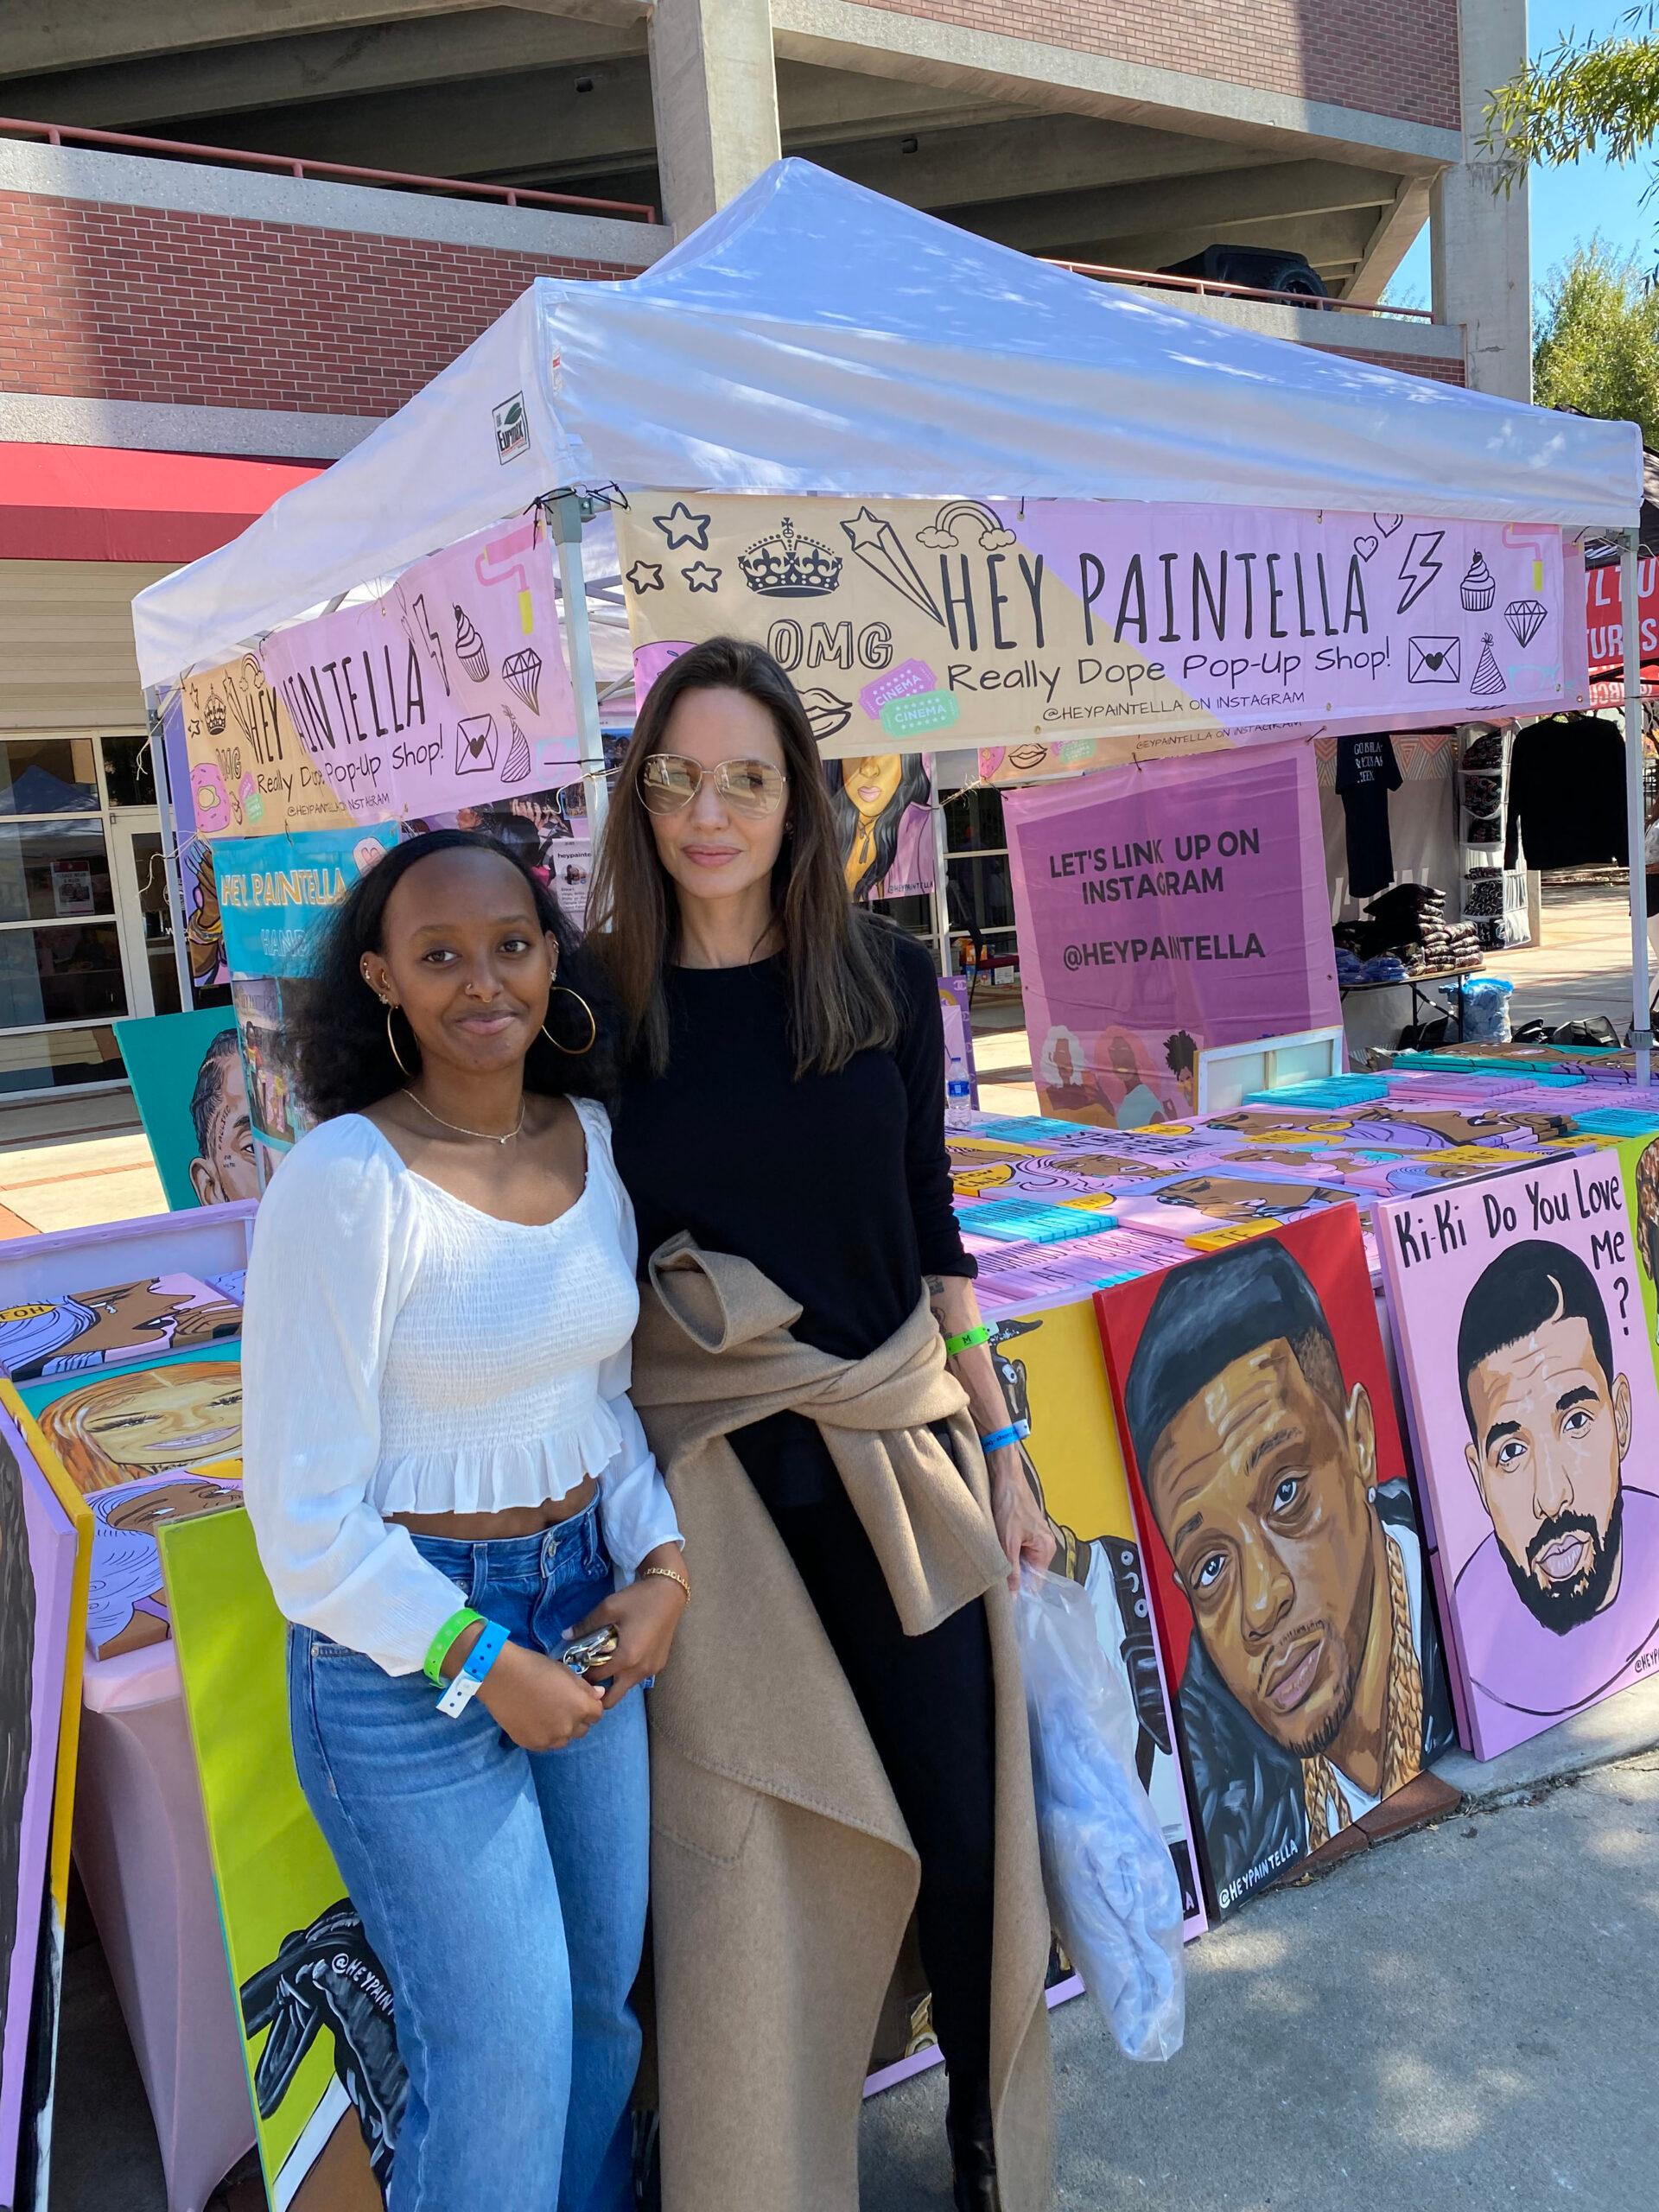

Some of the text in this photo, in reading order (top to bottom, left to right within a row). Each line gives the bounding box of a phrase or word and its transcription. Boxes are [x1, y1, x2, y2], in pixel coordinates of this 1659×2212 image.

[939, 550, 1369, 652] HEY PAINTELLA
[766, 619, 893, 672] OMG
[947, 636, 1391, 702] Really Dope Pop-Up Shop!
[874, 675, 922, 706] CINEMA
[894, 704, 947, 723] CINEMA
[1042, 692, 1305, 721] @HEYPAINTELLA ON INSTAGRAM
[245, 686, 283, 765] HEY
[1215, 728, 1230, 737] ON
[257, 768, 293, 803] Really
[392, 722, 444, 776] Shop!
[1049, 828, 1260, 879] LET'S LINK UP ON
[1394, 1168, 1622, 1268] Ki-Ki Do You Love
[1029, 1266, 1075, 1282] AF
[1139, 1251, 1181, 1266] AF
[1591, 1230, 1625, 1269] Me
[1613, 1276, 1629, 1336] ?
[1218, 1839, 1298, 1909] @HEYPAINTELLA
